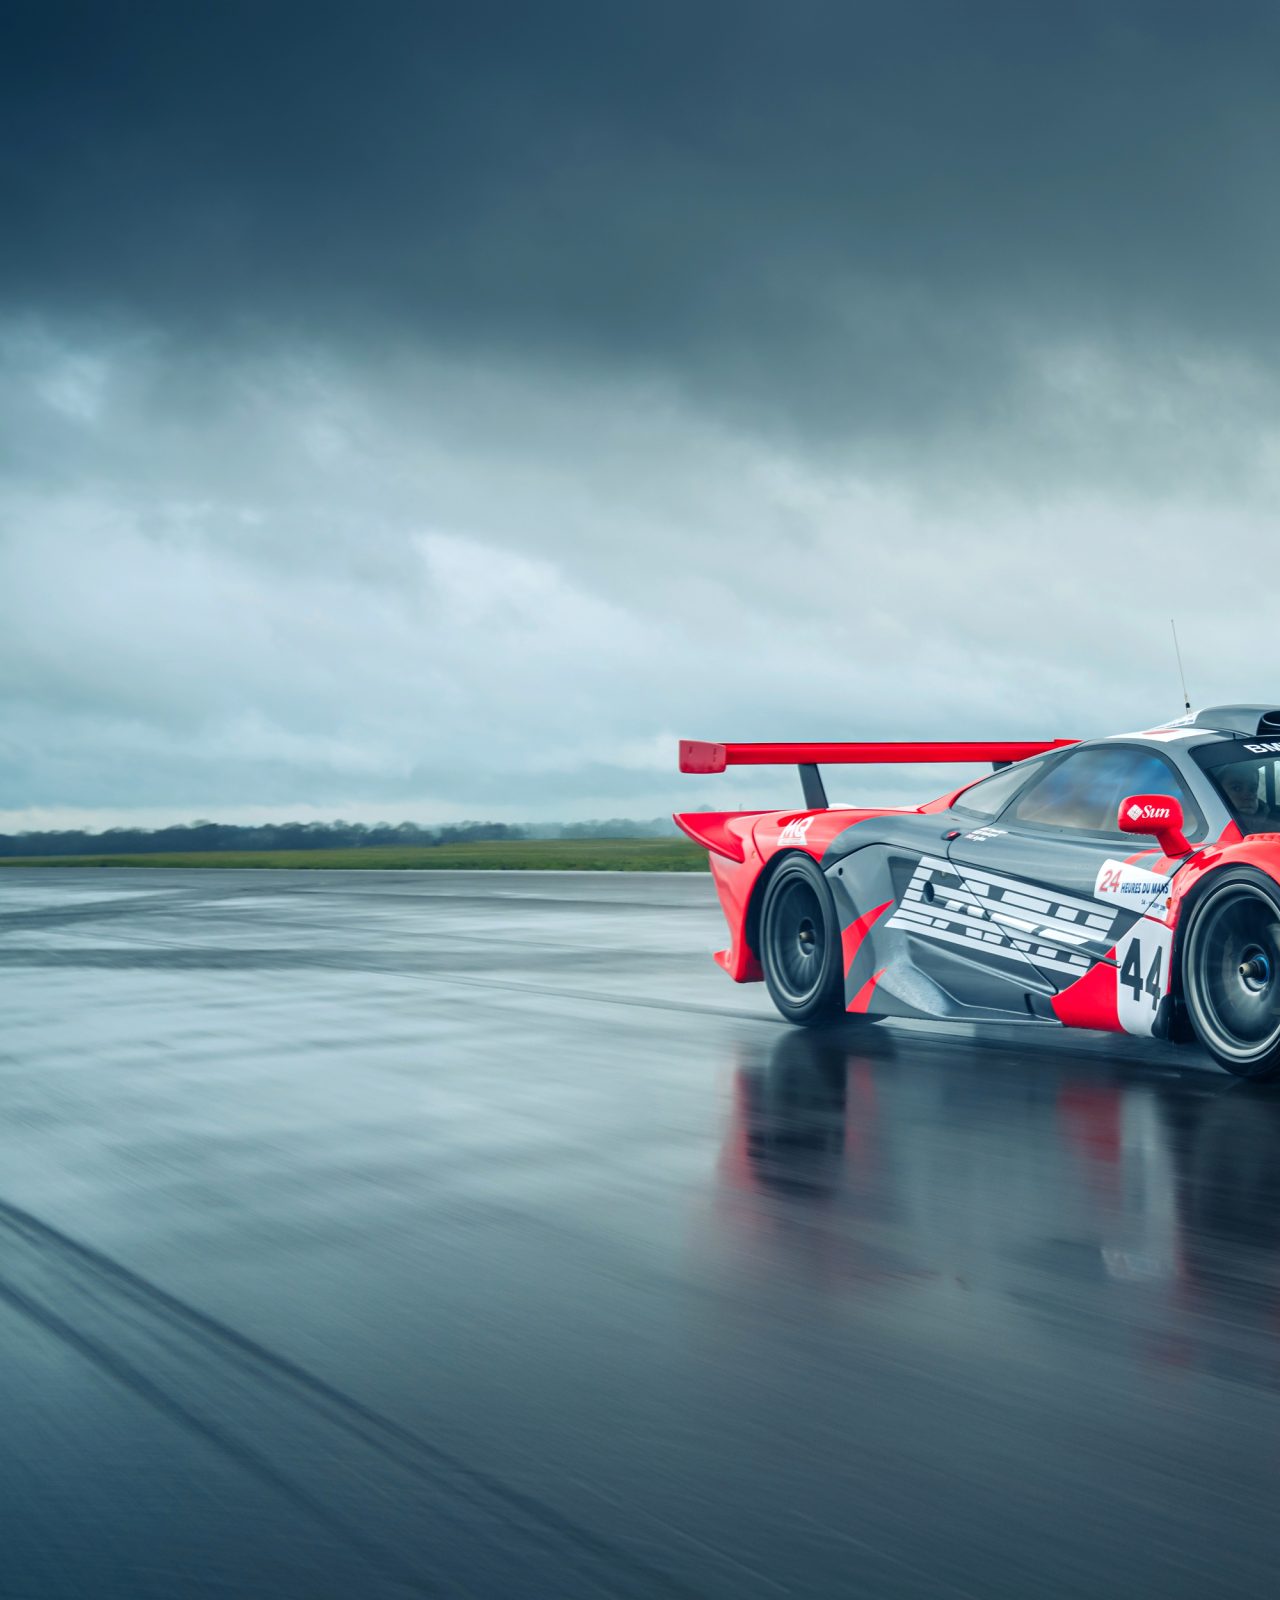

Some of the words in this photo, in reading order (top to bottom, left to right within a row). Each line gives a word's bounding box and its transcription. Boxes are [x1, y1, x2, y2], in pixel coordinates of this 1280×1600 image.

[1142, 805, 1170, 818] Sun
[1099, 869, 1122, 892] 24
[1121, 883, 1142, 893] HEURES
[1142, 883, 1151, 893] DU
[1151, 883, 1169, 894] MANS
[1120, 938, 1162, 1011] 44
